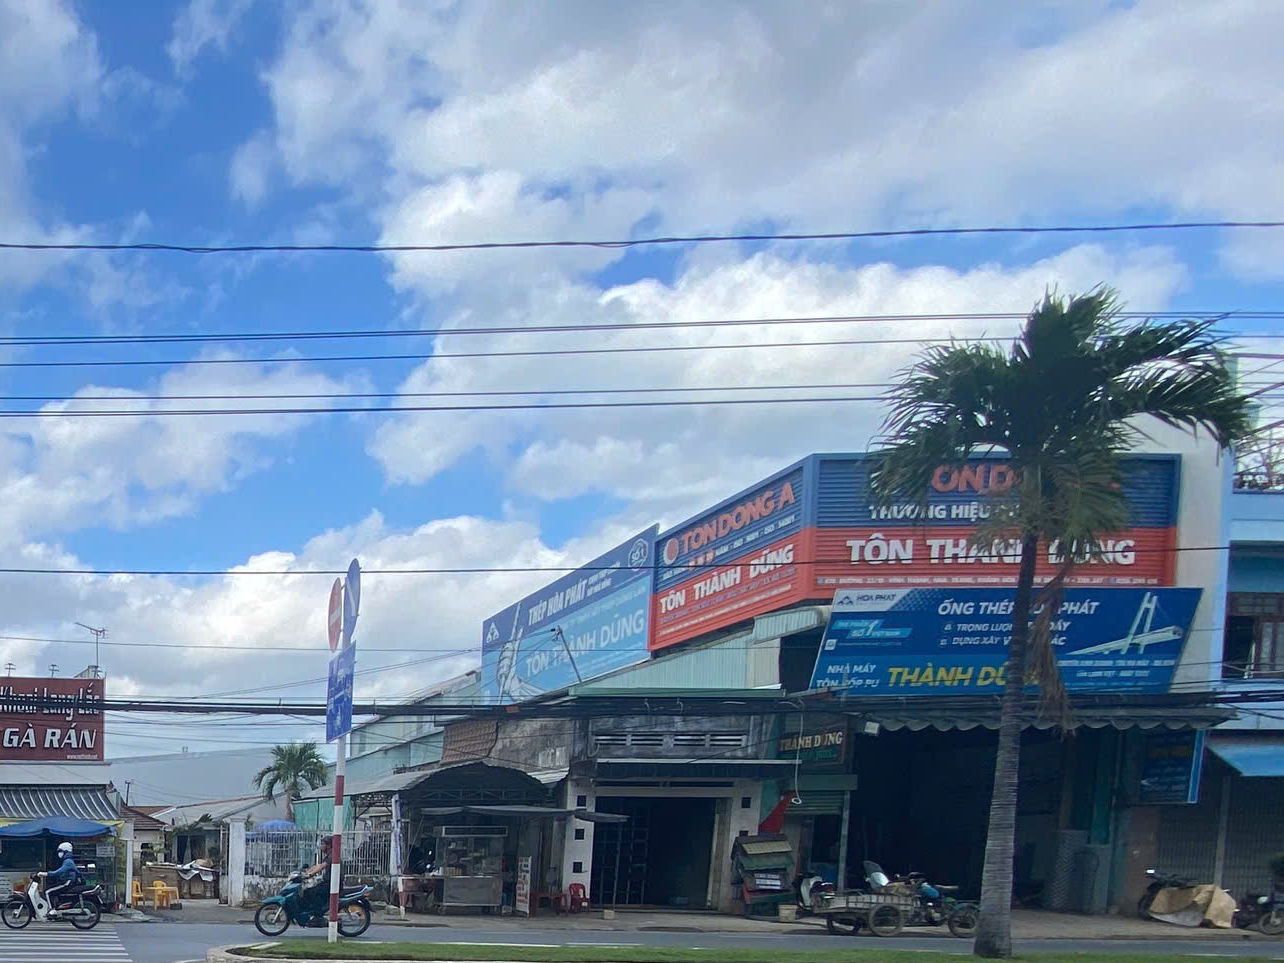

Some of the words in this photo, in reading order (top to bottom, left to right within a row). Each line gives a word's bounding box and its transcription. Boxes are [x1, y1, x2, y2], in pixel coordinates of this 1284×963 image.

[778, 482, 795, 509] A
[846, 532, 913, 565] TÔN
[660, 588, 686, 614] TÔN
[693, 566, 741, 601] THÀNH
[749, 544, 795, 578] DŨNG
[529, 599, 547, 626] THÉP
[564, 578, 588, 608] PHÁT
[938, 598, 974, 616] ỐNG
[1057, 598, 1101, 615] PHÁT
[957, 623, 989, 635] TRỌNG
[526, 650, 549, 677] TÔN
[853, 662, 877, 674] MÁY
[888, 661, 974, 687] THÀNH
[2, 722, 37, 748] GÀ
[44, 722, 97, 749] RÁN
